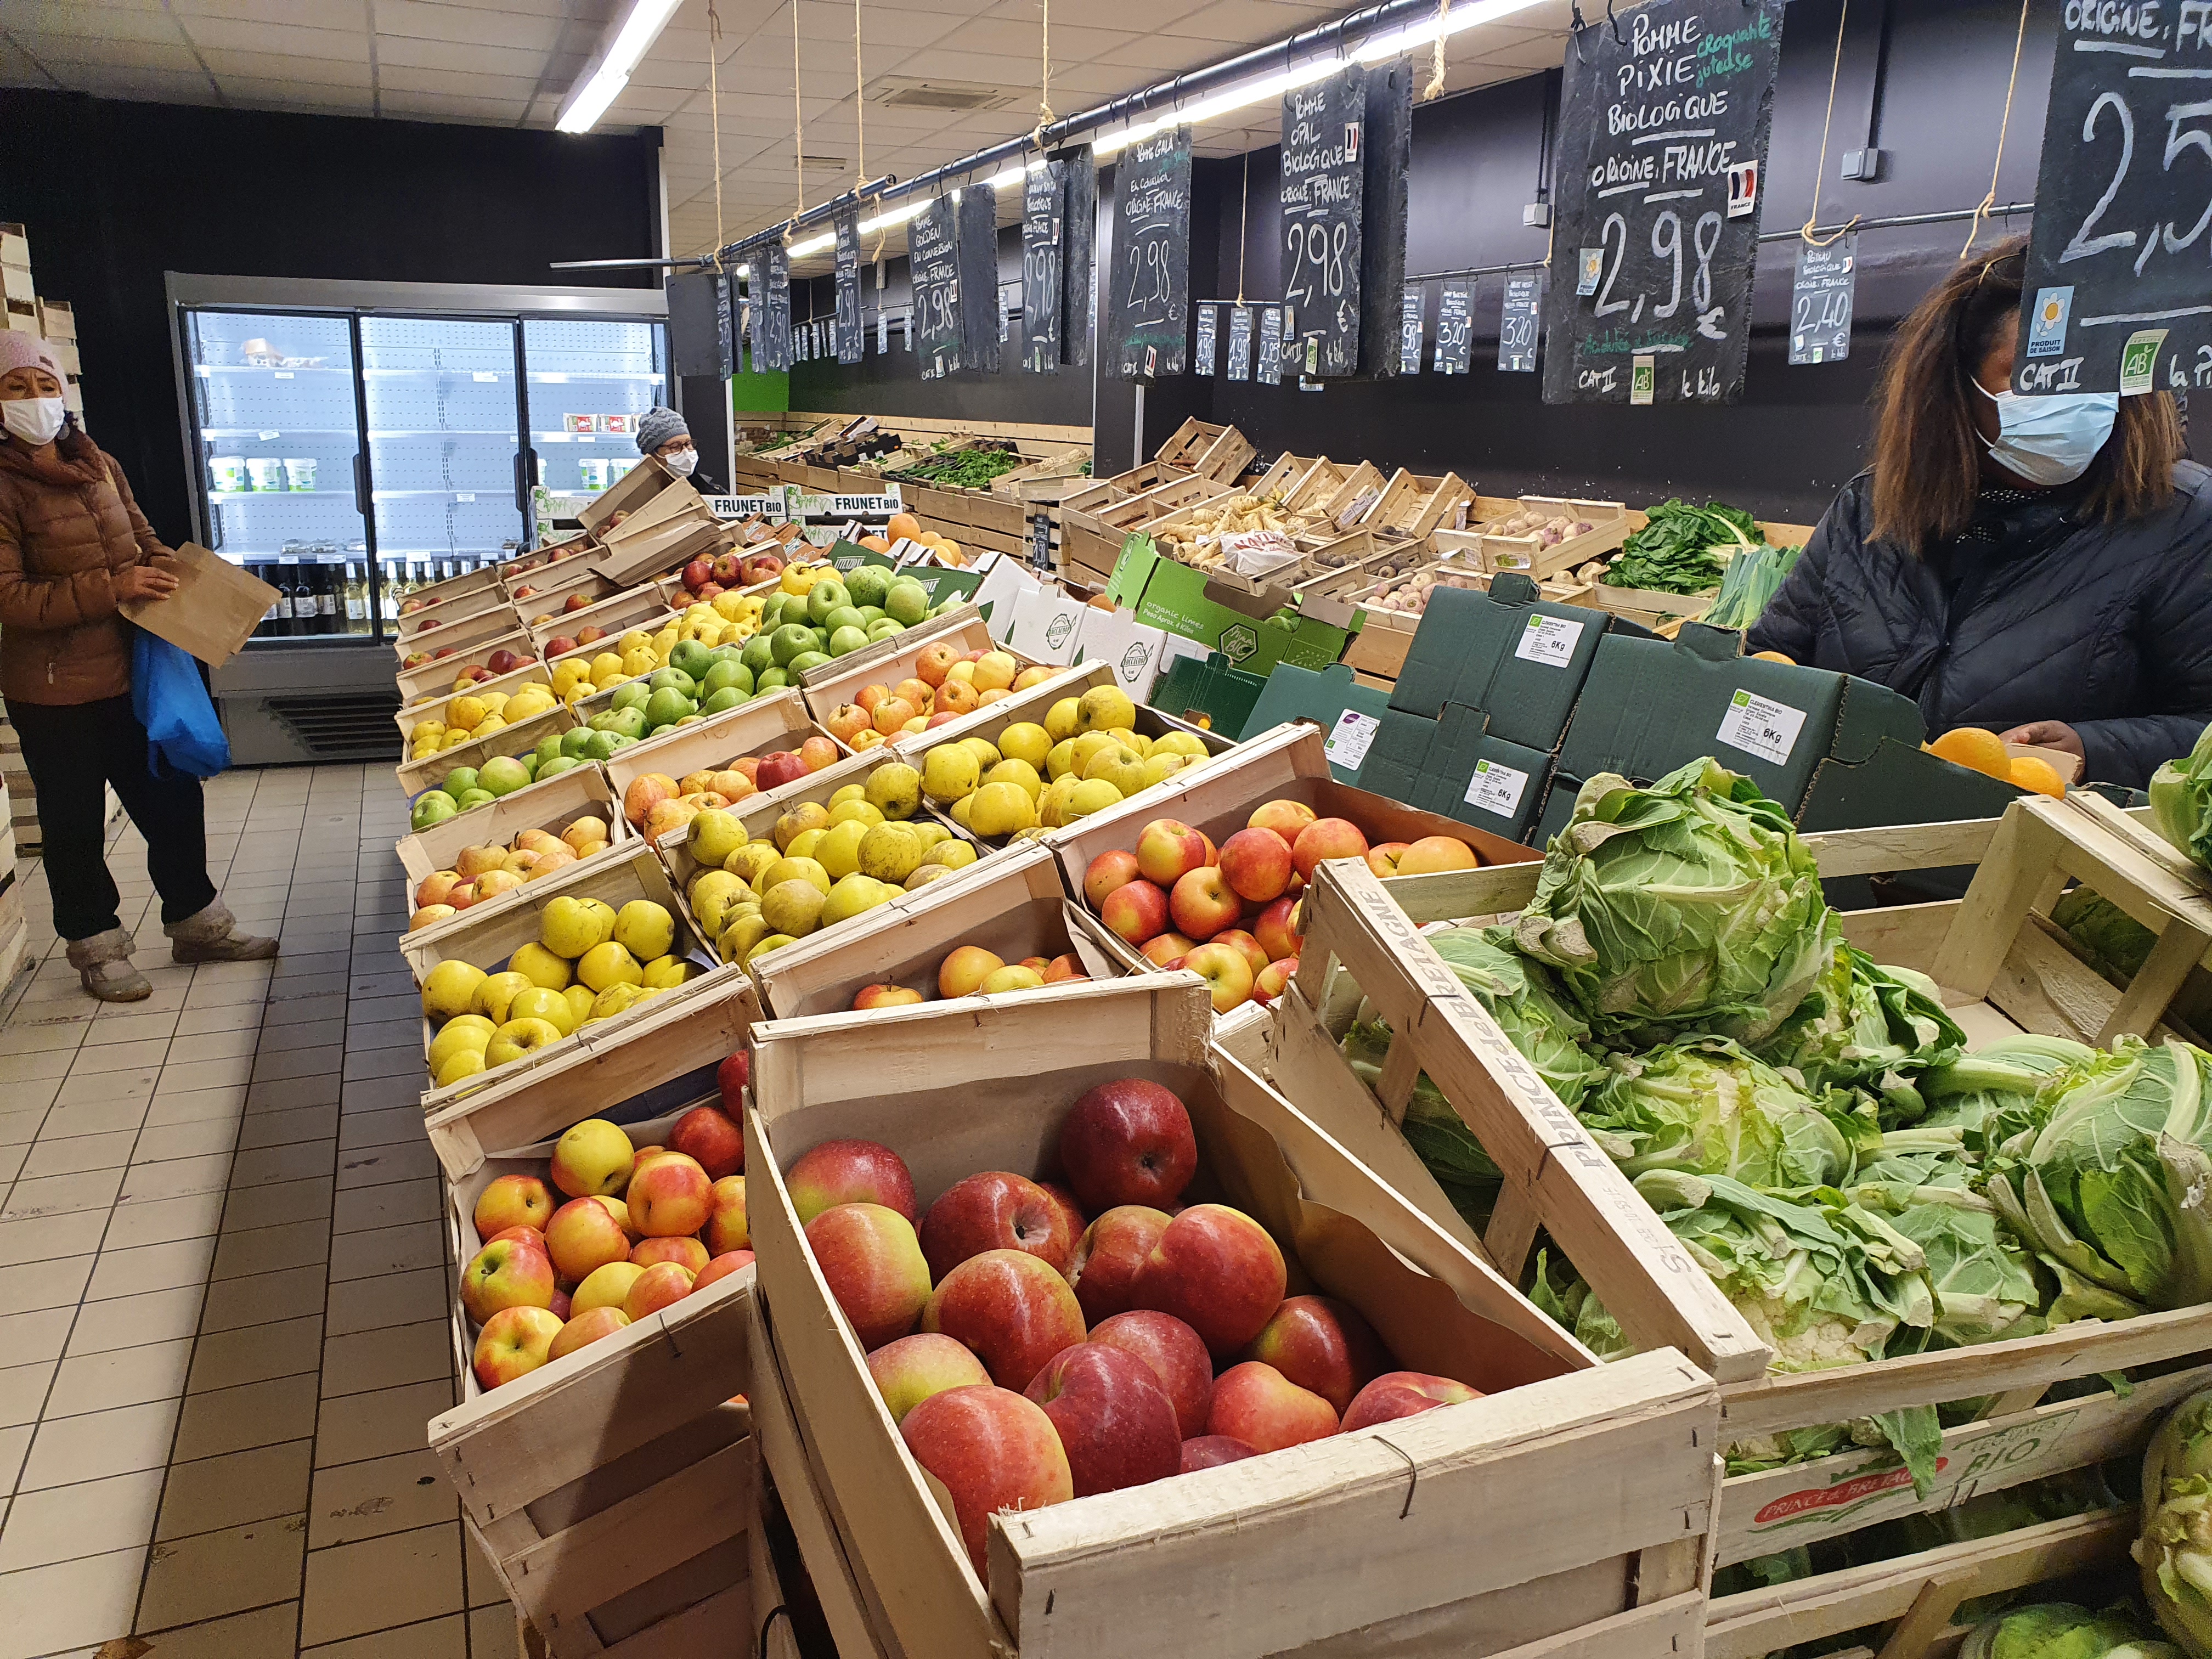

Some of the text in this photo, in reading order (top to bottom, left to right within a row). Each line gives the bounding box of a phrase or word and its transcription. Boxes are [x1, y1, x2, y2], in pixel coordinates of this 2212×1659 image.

[1632, 13, 1702, 58] POMME
[1295, 91, 1326, 121] POMME
[1291, 121, 1321, 146] OPAL
[1154, 136, 1173, 158] GALA
[1662, 140, 1737, 183] FRANCE
[1154, 189, 1184, 213] FRANCE
[1314, 175, 1351, 206] FRANCE
[1731, 201, 1751, 210] FRANCE
[915, 223, 941, 247] GOLDEN
[929, 263, 955, 282] FRANCE
[1127, 240, 1170, 313] 2,98
[1285, 221, 1347, 308] 2,98
[1594, 210, 1723, 323] 2,98
[1820, 277, 1850, 288] FRANCE
[918, 286, 953, 341] 2,98
[1796, 291, 1848, 347] 2,40 €
[1438, 321, 1466, 347] 3,20
[1502, 315, 1532, 349] 3,20
[1197, 337, 1213, 362] 1,98
[1229, 337, 1247, 362] 1,98
[1260, 341, 1280, 364] 2,85
[2019, 362, 2060, 391] CAT
[2125, 353, 2148, 376] AB
[1578, 368, 1602, 390] CAT
[1634, 374, 1650, 391] AB
[1697, 366, 1720, 396] kilo
[714, 499, 782, 512] FRUNET BIO
[835, 496, 899, 510] FRUNET BIO
[1143, 608, 1157, 619] Peso
[1180, 623, 1194, 634] Kilos
[1147, 601, 1180, 619] organic
[1551, 640, 1566, 652] 6Kg
[1763, 728, 1782, 744] 6Kg
[1498, 788, 1511, 801] 6Kg
[1358, 890, 1482, 1020] BRETAGNE
[1496, 1057, 1607, 1169] PRINCE
[1763, 1491, 1829, 1519] PRINCE
